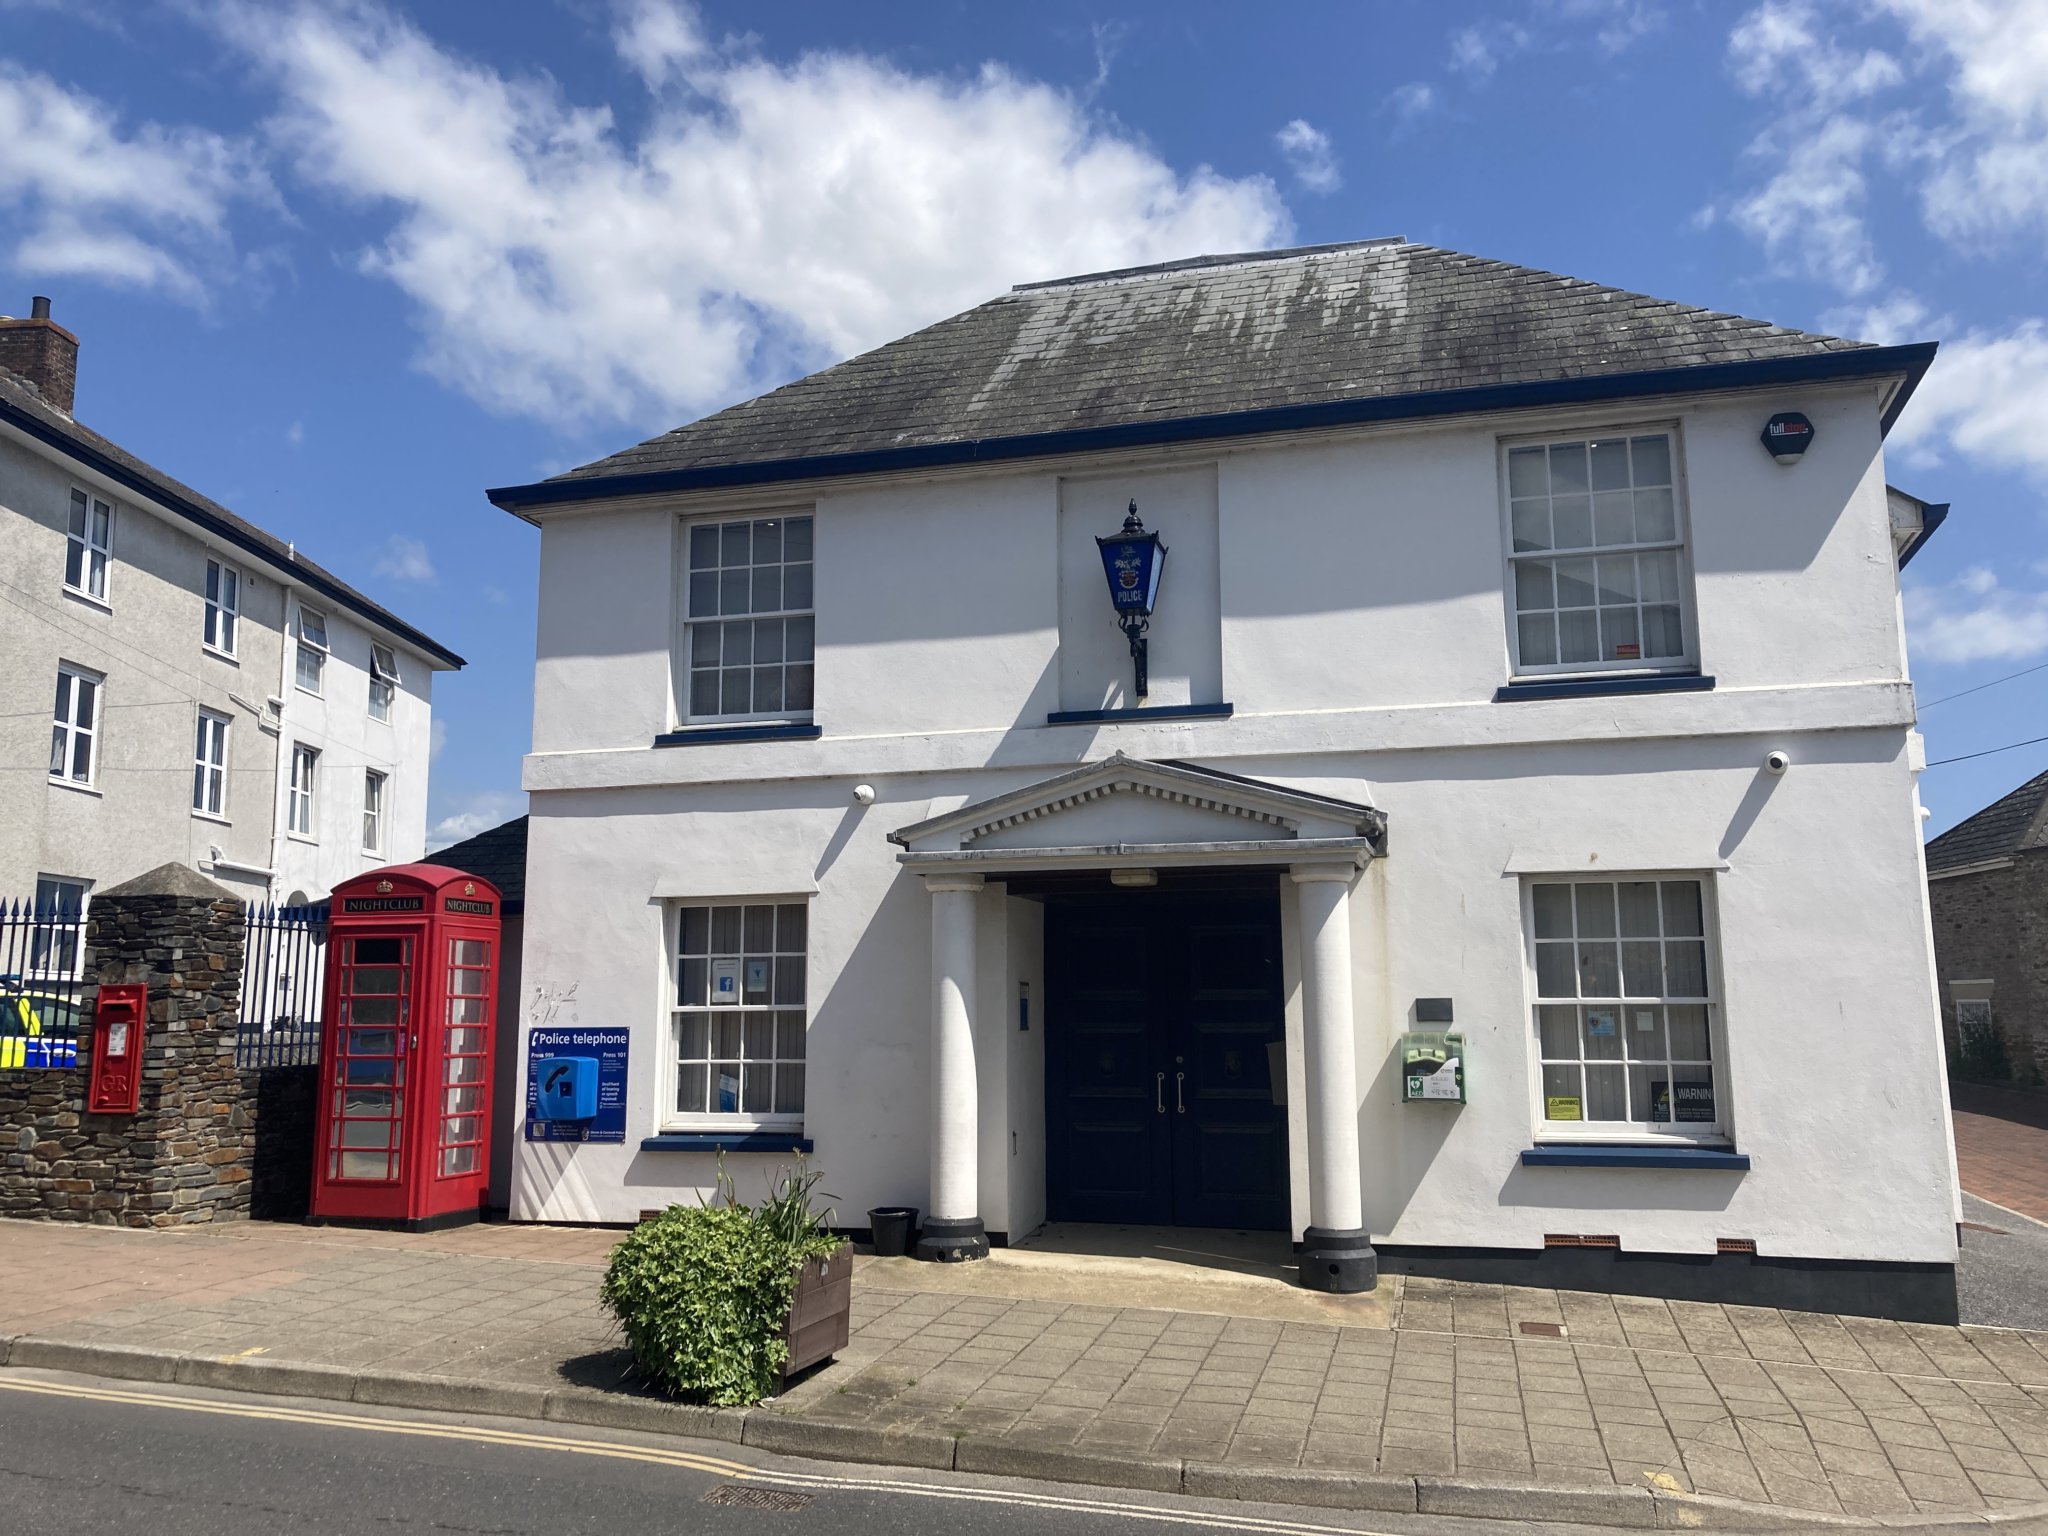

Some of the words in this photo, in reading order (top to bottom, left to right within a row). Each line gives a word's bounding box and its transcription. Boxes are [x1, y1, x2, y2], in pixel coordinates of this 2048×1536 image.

[1118, 590, 1143, 603] POLICE
[350, 898, 419, 911] NIGHTCLUB
[447, 899, 491, 914] NIGHTCLUB
[539, 1033, 570, 1044] Police
[573, 1033, 627, 1046] telephone
[102, 1075, 127, 1091] GR
[1678, 1087, 1714, 1100] WARNIN
